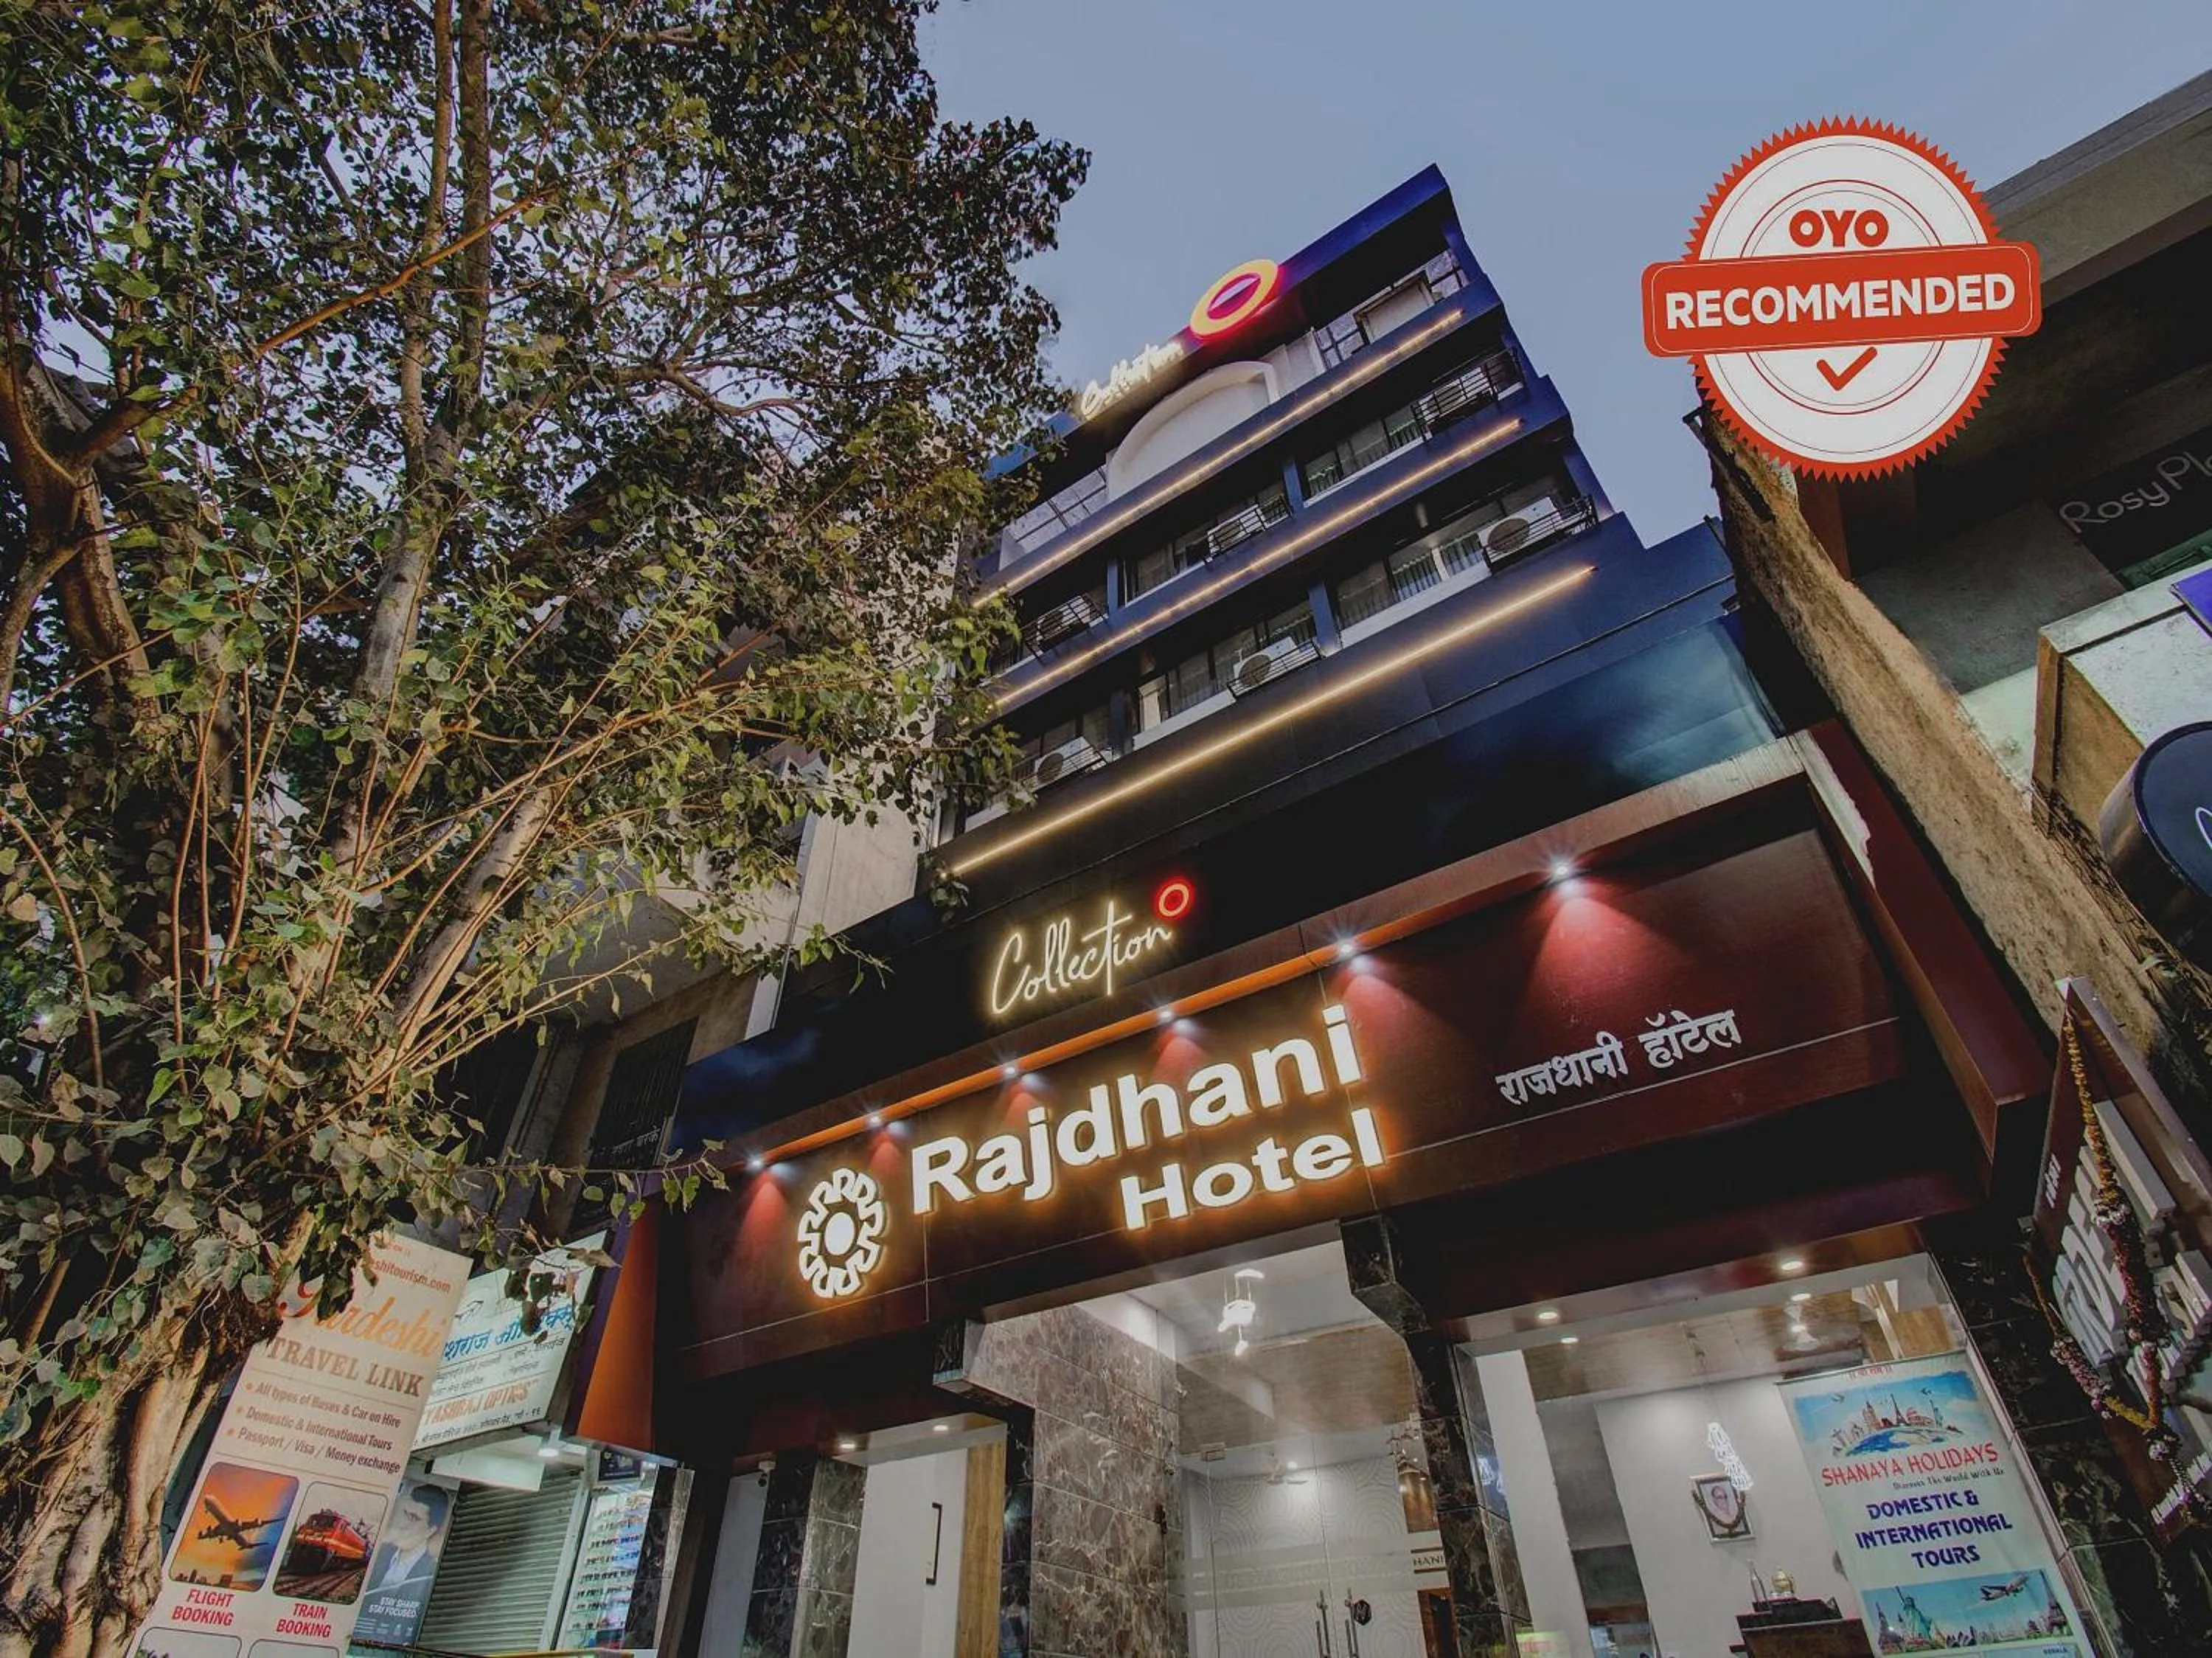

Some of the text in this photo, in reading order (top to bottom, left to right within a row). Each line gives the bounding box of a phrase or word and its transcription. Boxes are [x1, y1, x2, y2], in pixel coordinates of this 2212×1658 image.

[992, 901, 1172, 1015] Collection
[1495, 1010, 1742, 1106] राजधानी हॉटेल
[911, 1004, 1363, 1214] Rajdhani
[1121, 1108, 1385, 1230] Hotel
[372, 1260, 451, 1294] shitourism.com
[267, 1336, 360, 1381] TRAVEL
[366, 1362, 424, 1397] LINK
[256, 1382, 270, 1395] All
[271, 1385, 296, 1404] types
[299, 1394, 313, 1405] of
[341, 1404, 350, 1415] &
[352, 1406, 368, 1418] Car
[369, 1412, 380, 1423] on
[382, 1413, 401, 1428] Hire
[238, 1426, 285, 1451] Passport
[294, 1439, 316, 1455] Visa
[325, 1446, 358, 1466] Money
[358, 1454, 400, 1474] exchange
[246, 1406, 393, 1451] Domestic & International Tours
[1820, 1442, 1999, 1488] SHANAYA HOLIDAYS
[1866, 1489, 1980, 1520] DOMESTIC &
[1855, 1513, 2013, 1549] INTERNATIONAL
[1910, 1544, 1981, 1569] TOURS
[171, 1606, 234, 1626] BOOKING
[186, 1589, 234, 1607] FLIGHT
[292, 1603, 328, 1620] TRAIN
[276, 1619, 332, 1639] BOOKING
